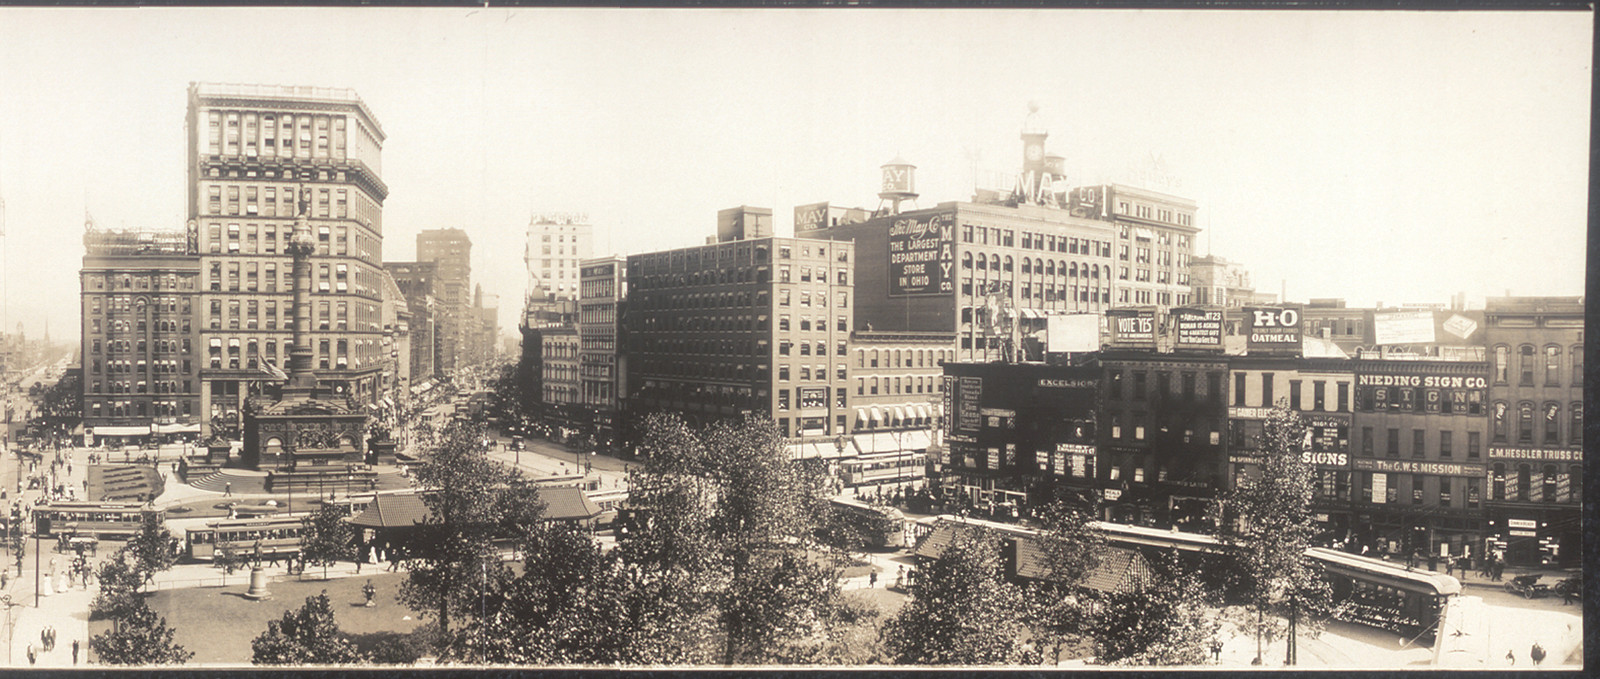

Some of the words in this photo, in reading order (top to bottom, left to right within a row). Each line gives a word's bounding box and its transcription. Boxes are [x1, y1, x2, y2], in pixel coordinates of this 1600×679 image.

[884, 170, 905, 182] AY
[1014, 170, 1070, 209] MAY
[796, 209, 827, 225] MAY
[890, 241, 904, 251] THE
[907, 238, 939, 250] LARGEST
[892, 250, 938, 264] DEPARTMENT
[941, 226, 953, 278] MAY
[903, 263, 926, 275] STORE
[899, 277, 908, 287] IN
[911, 275, 929, 287] OHIO
[1212, 312, 1221, 321] 23
[1118, 318, 1136, 332] VOTE
[1251, 333, 1298, 343] OATMEAL
[1359, 374, 1421, 386] NIEDING
[1424, 375, 1463, 388] SIGN
[1465, 377, 1487, 388] CO.
[1302, 451, 1348, 465] SIGNS
[1504, 448, 1542, 459] HESSLER
[1543, 450, 1571, 460] TRUSS
[1377, 460, 1392, 470] The
[1420, 463, 1461, 474] MISSION
